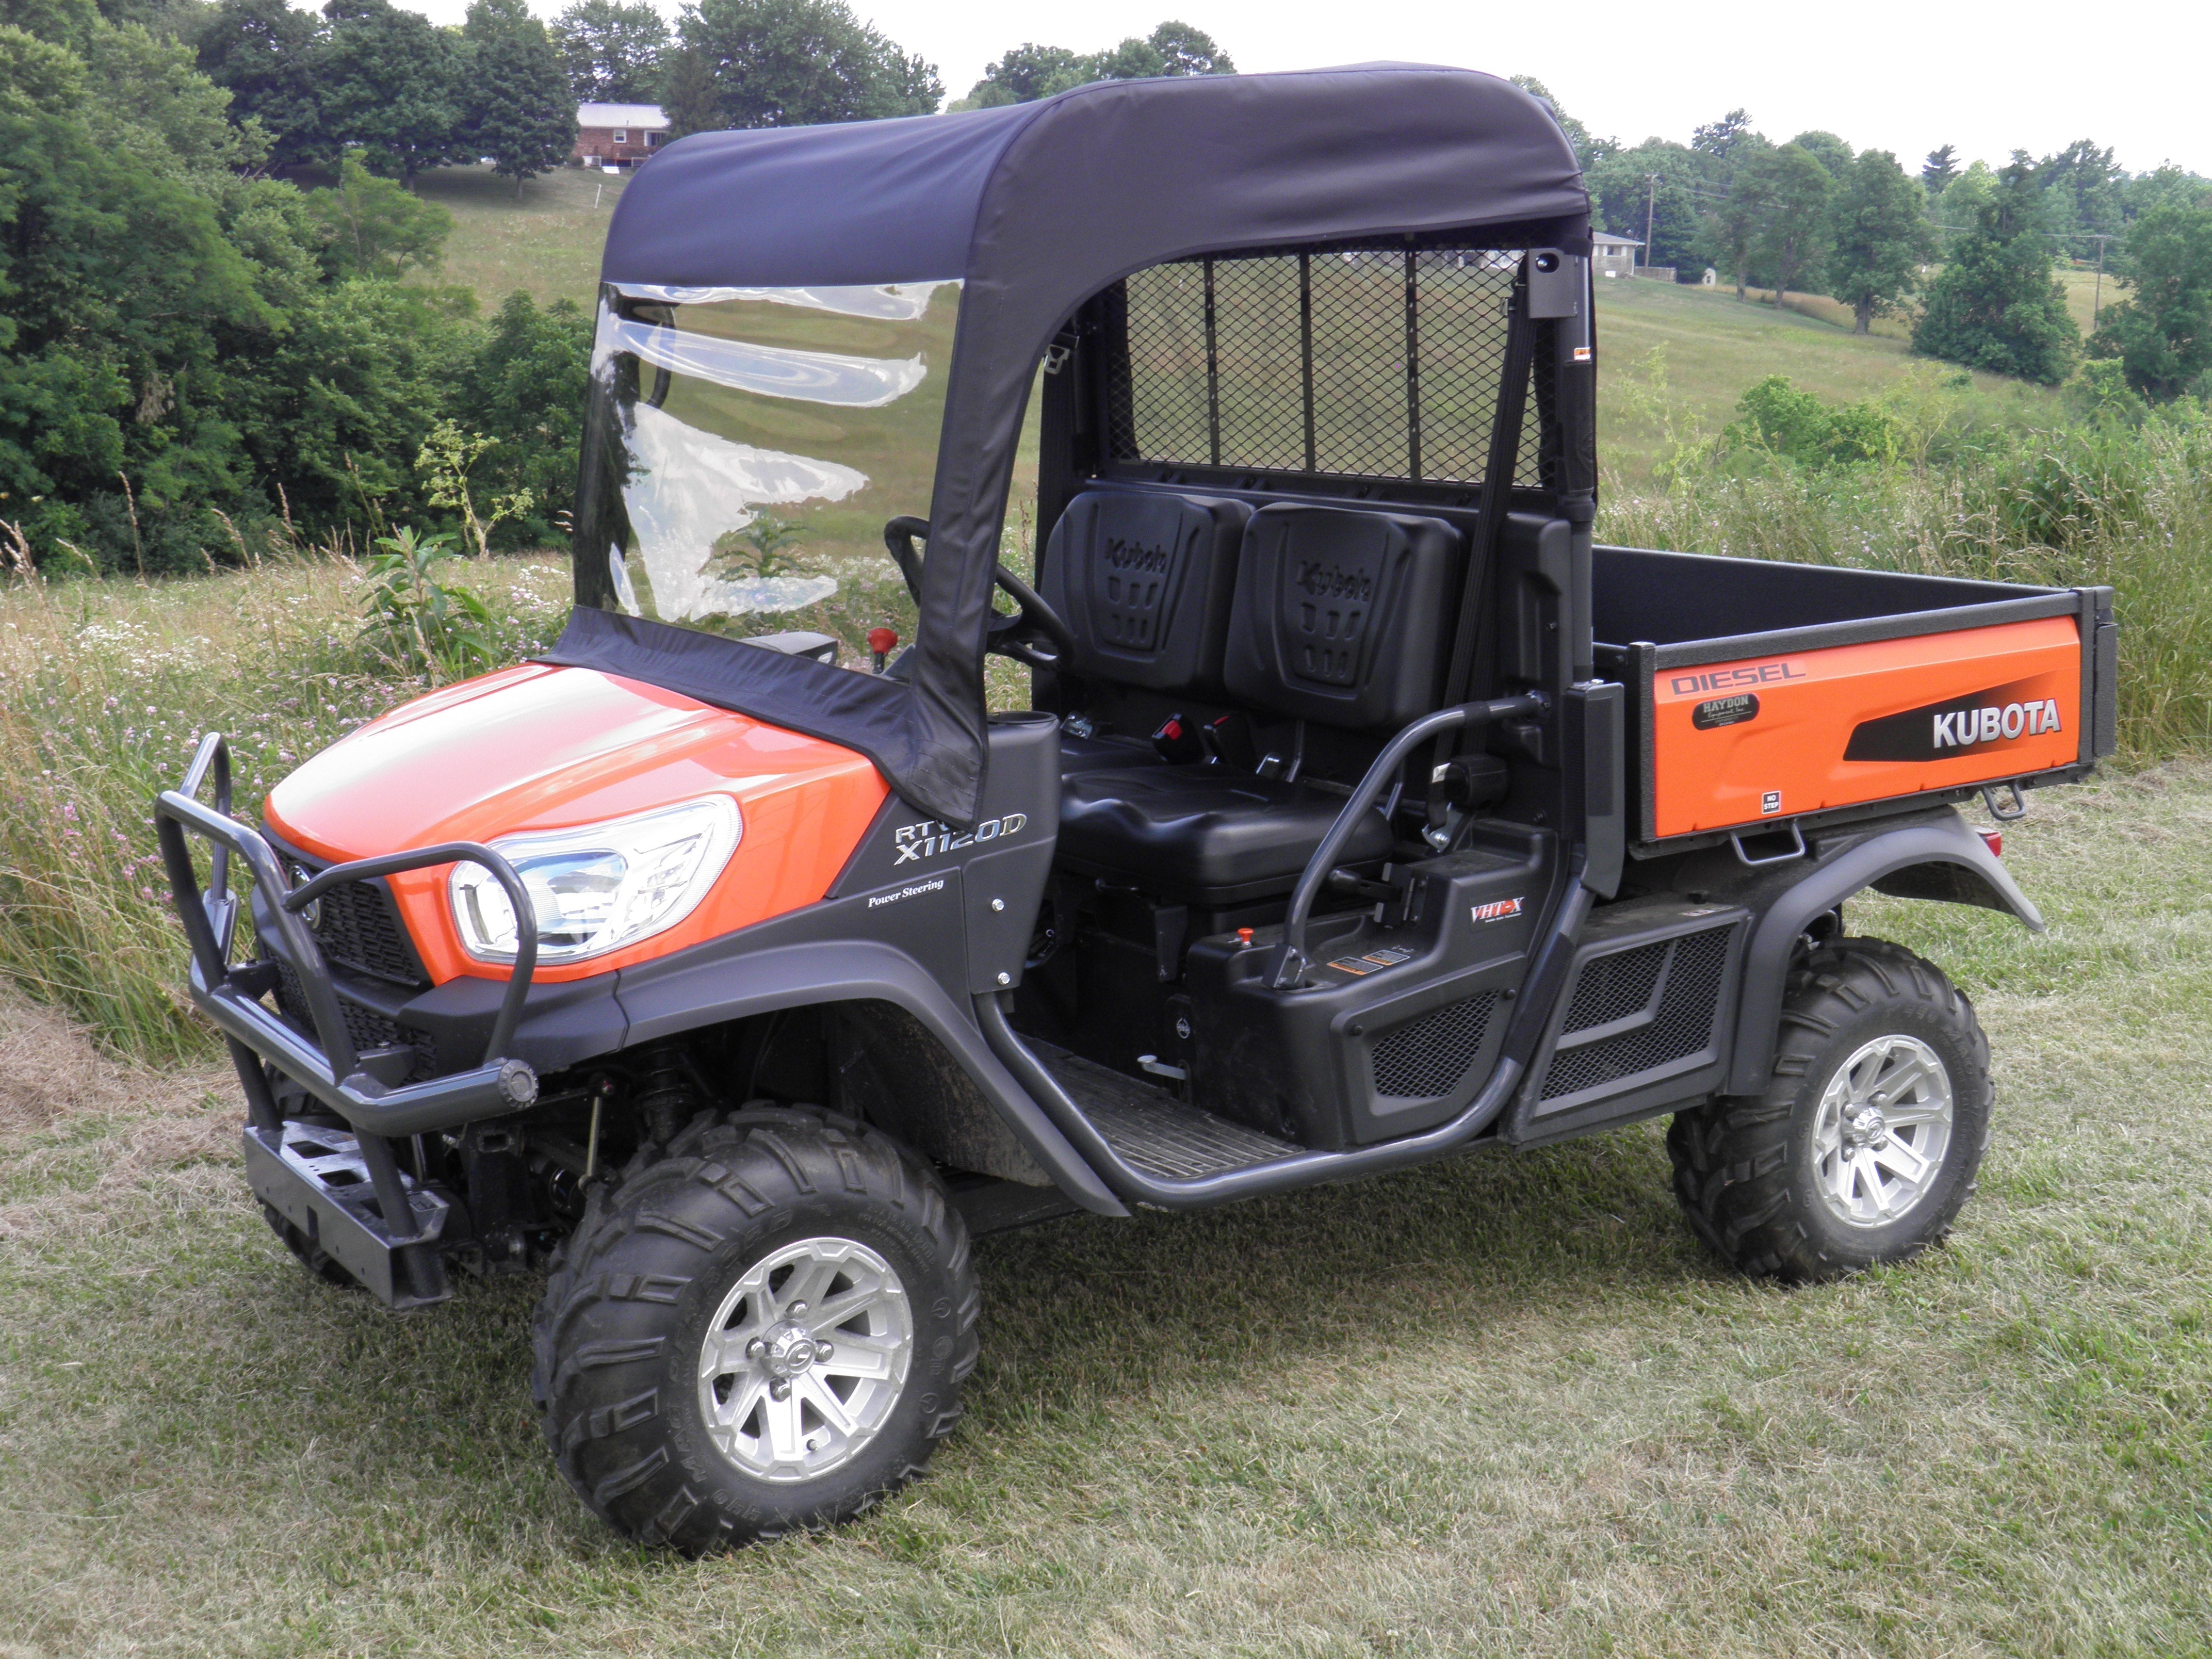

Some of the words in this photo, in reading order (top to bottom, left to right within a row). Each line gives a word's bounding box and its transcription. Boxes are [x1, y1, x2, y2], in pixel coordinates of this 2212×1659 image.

[1671, 662, 1806, 695] DIESEL
[1703, 695, 1749, 713] HAYDON
[1933, 698, 2061, 749] KUBOTA
[1764, 802, 1779, 810] STEP
[893, 813, 1028, 866] X1120D
[868, 891, 901, 908] Power
[902, 879, 945, 898] Steering
[1470, 897, 1525, 923] VHT-X
